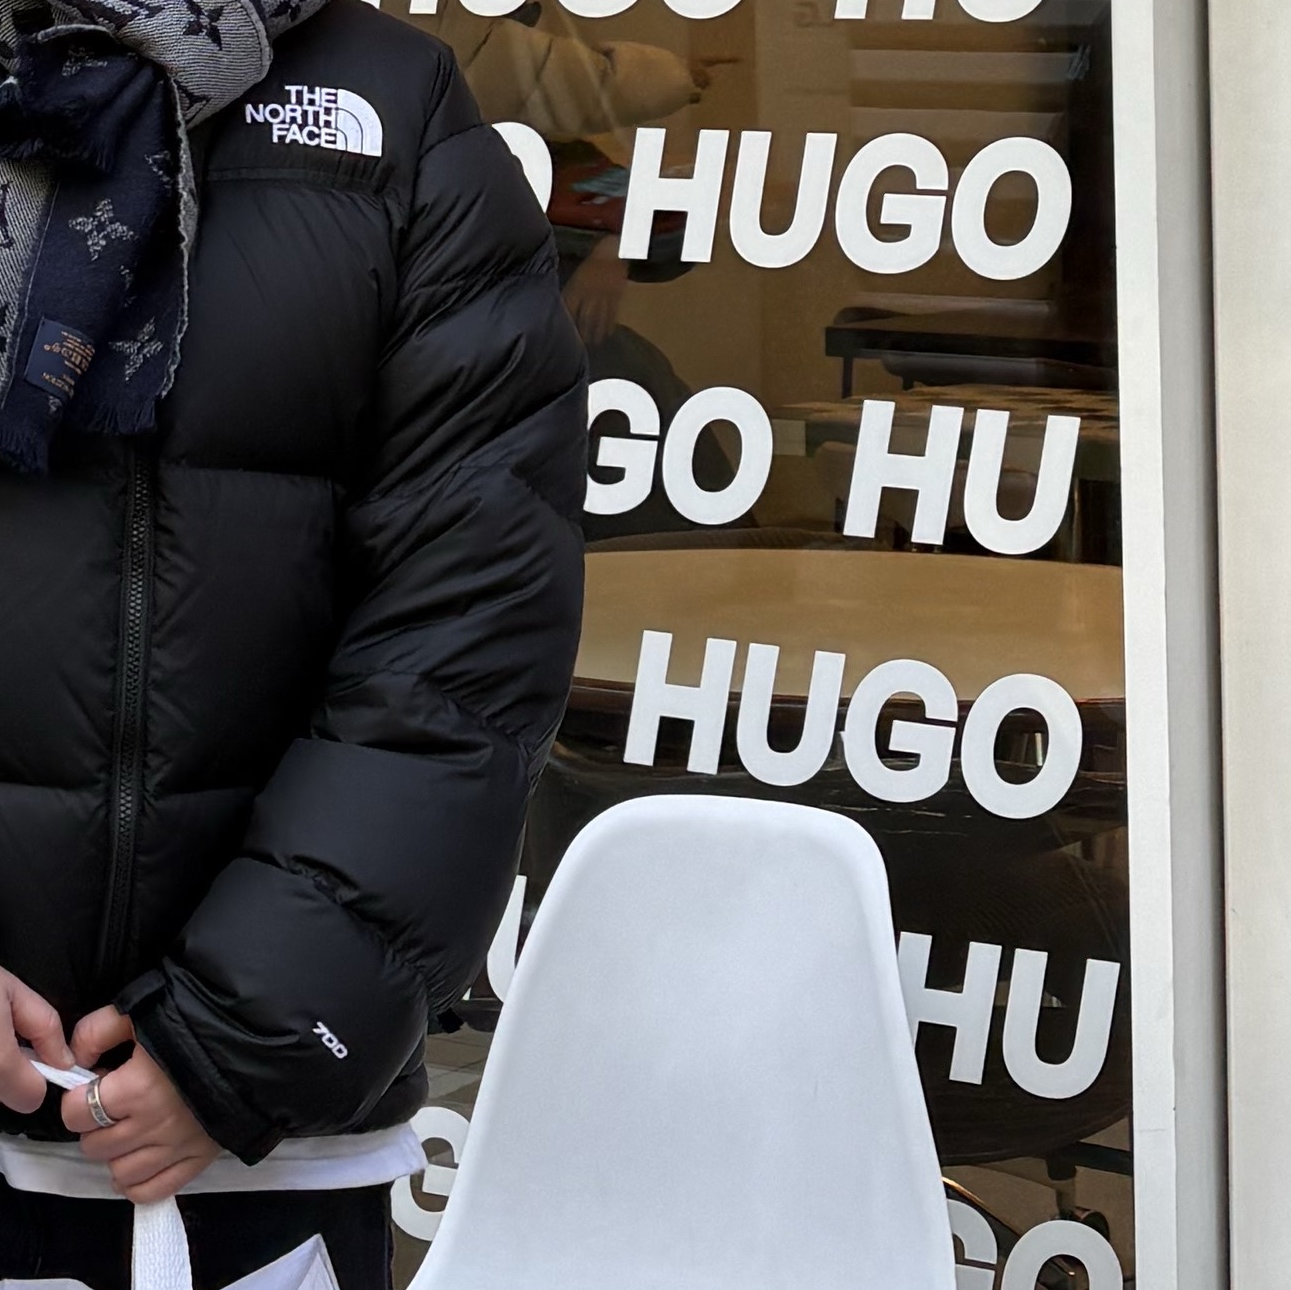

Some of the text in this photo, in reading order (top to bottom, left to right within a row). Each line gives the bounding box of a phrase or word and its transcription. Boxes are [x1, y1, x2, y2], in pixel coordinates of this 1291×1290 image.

[245, 103, 337, 129] NORTH
[272, 124, 338, 149] FACE
[285, 85, 338, 108] THE
[618, 127, 1072, 281] HUGO
[583, 378, 1081, 555] GO HU
[623, 630, 1083, 819] HUGO
[312, 1021, 348, 1059] 700
[897, 931, 1121, 1100] HU
